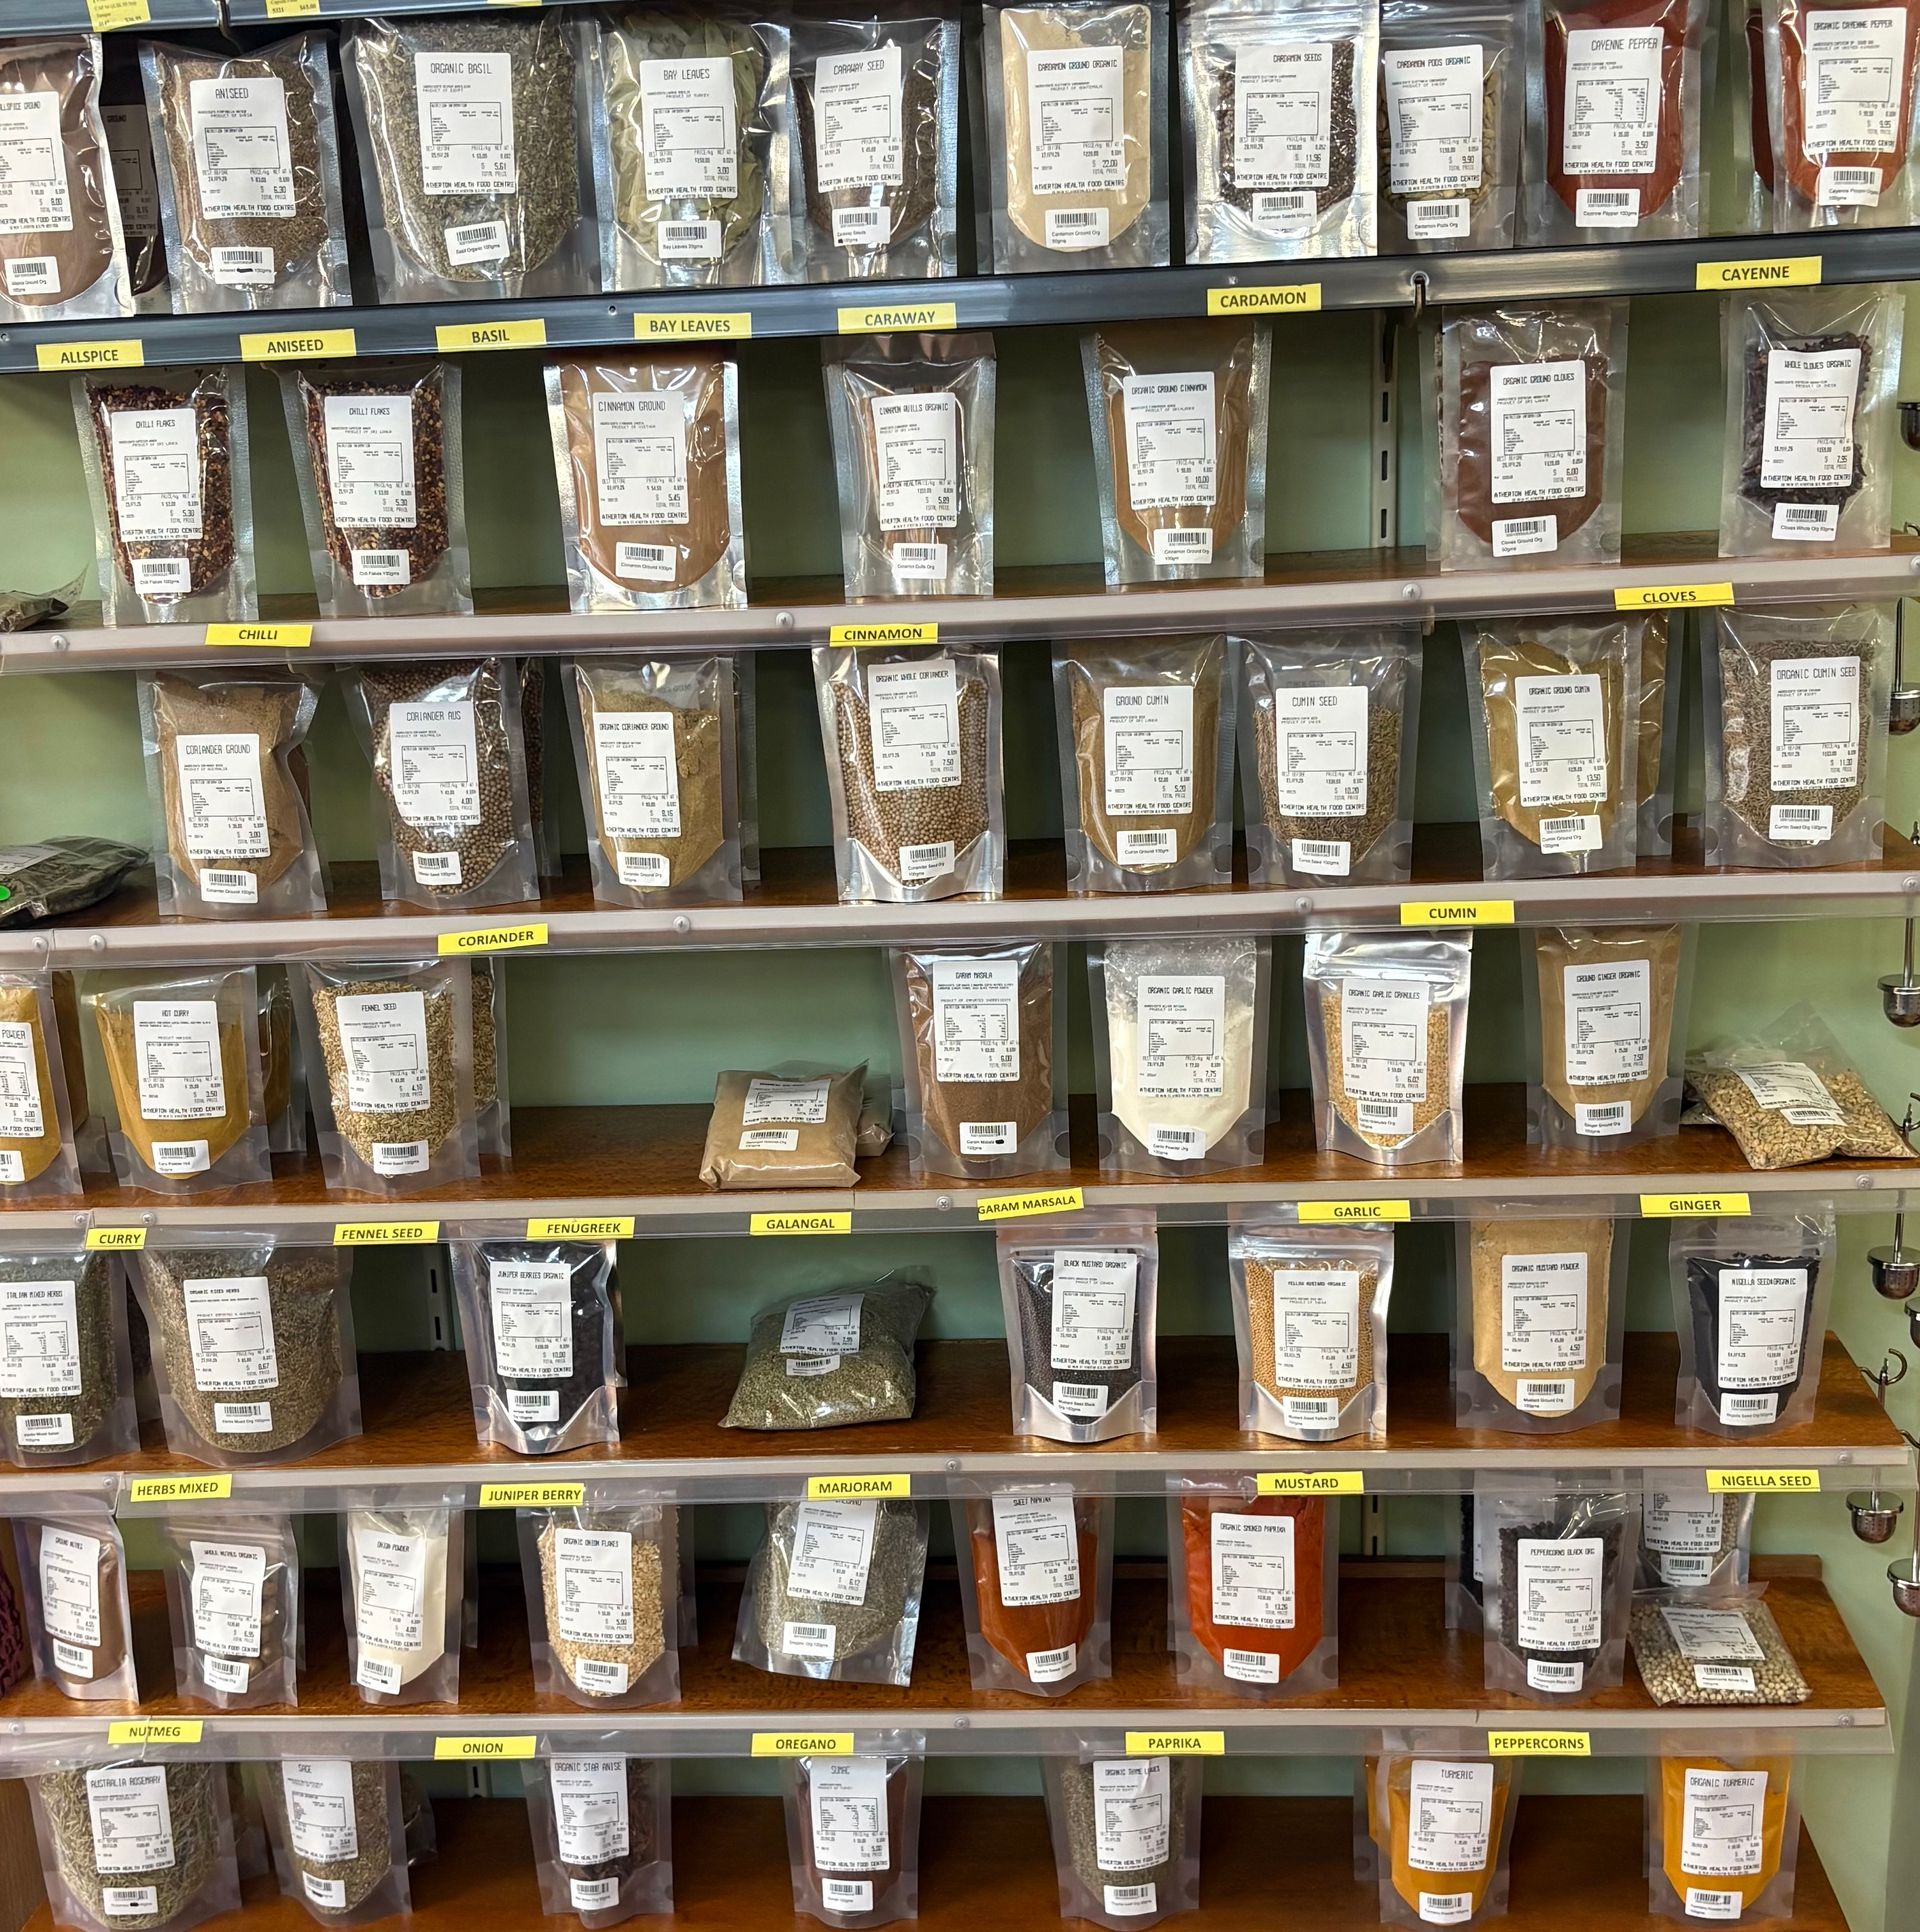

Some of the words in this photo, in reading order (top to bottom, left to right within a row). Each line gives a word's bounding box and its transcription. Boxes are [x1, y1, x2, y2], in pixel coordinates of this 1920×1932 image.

[1591, 39, 1625, 51] CAYENNE
[1628, 38, 1659, 50] PEPPER
[1304, 54, 1322, 62] SEEDS
[1428, 59, 1442, 67] PODS
[1445, 56, 1471, 66] ORGANIC
[430, 63, 464, 74] ORGANIC
[468, 63, 493, 74] BASIL
[834, 63, 864, 75] CARAWAY
[868, 60, 885, 72] SEED
[1038, 62, 1066, 72] CARDAMON
[1068, 61, 1090, 70] GROUND
[1092, 60, 1118, 69] ORGANIC
[664, 70, 677, 81] BAY
[682, 69, 710, 80] LEAVES
[216, 88, 249, 99] ANISEED
[1722, 266, 1790, 281] CAYENNE
[1221, 292, 1306, 309] CARDAMON
[865, 311, 935, 326] CARAWAY
[650, 321, 678, 333] BAY
[682, 320, 731, 333] LEAVES
[472, 328, 509, 343] BASIL
[267, 338, 324, 353] ANISEED
[61, 350, 119, 364] ALLSPICE
[1784, 361, 1801, 369] WHOLE
[1804, 362, 1824, 370] CLOVES
[1827, 360, 1852, 368] ORGANIC
[1503, 376, 1528, 385] ORGANIC
[1530, 375, 1551, 384] GROUND
[1554, 373, 1575, 382] CLOVES
[1132, 387, 1155, 395] ORGANIC
[1157, 385, 1178, 394] GROUND
[1180, 384, 1208, 393] CINNAMON
[349, 408, 368, 416] CHILLI
[371, 408, 390, 416] FLAKES
[598, 401, 635, 412] CINNAMON
[639, 401, 666, 411] GROUND
[136, 421, 154, 429] CHILLI
[157, 420, 176, 428] FLAKES
[1643, 590, 1697, 604] CLOVES
[238, 629, 278, 641] CHILLI
[844, 627, 922, 641] CINNAMON
[1776, 669, 1810, 680] ORGANIC
[1812, 668, 1837, 679] CUMIN
[1840, 666, 1859, 677] SEED
[1116, 696, 1143, 706] GROUND
[1146, 695, 1169, 706] CUMIN
[1292, 696, 1315, 707] CUMIN
[1318, 696, 1338, 707] SEED
[406, 711, 444, 722] CORIANDER
[447, 710, 462, 720] AUS
[186, 744, 222, 755] CORIANDER
[226, 744, 251, 754] GROUND
[1429, 908, 1477, 919] CUMIN
[458, 930, 534, 947] CORIANDER
[1148, 987, 1170, 995] ORGANIC
[1172, 987, 1192, 995] GARLIC
[1194, 987, 1214, 995] POWDER
[362, 1004, 381, 1012] FENNEL
[383, 1003, 398, 1011] SEED
[2, 1030, 26, 1040] POWDER
[978, 1202, 1019, 1216] GARAM
[1022, 1196, 1076, 1210] MARSALA
[1669, 1199, 1722, 1212] GINGER
[1334, 1206, 1381, 1218] GARLIC
[547, 1222, 620, 1234] FENUGREEK
[766, 1218, 835, 1230] GALANGAL
[99, 1233, 141, 1245] CURRY
[342, 1228, 387, 1240] FENNEL
[392, 1227, 423, 1239] SEED
[818, 1480, 892, 1494] MARJORAM
[1275, 1477, 1338, 1490] MUSTARD
[1722, 1476, 1776, 1488] NIGELLA
[1779, 1475, 1812, 1487] SEED
[137, 1483, 175, 1497] HERBS
[178, 1482, 218, 1495] MIXED
[489, 1489, 539, 1502] JUNIPER
[542, 1488, 582, 1501] BERRY
[129, 1726, 181, 1739] NUTMEG
[463, 1742, 504, 1755] ONION
[776, 1738, 836, 1751] OREGANO
[1148, 1737, 1201, 1750] PAPRIKA
[1494, 1737, 1585, 1750] PEPPERCORNS
[555, 1763, 581, 1772] ORGANIC
[583, 1762, 600, 1772] STAR
[602, 1761, 622, 1771] ANISE
[1441, 1769, 1474, 1780] TURMERIC
[91, 1778, 127, 1788] AUSTRALIA
[129, 1776, 161, 1787] ROSEMARY
[1690, 1777, 1720, 1788] ORGANIC
[1723, 1778, 1755, 1788] TURMERIC
